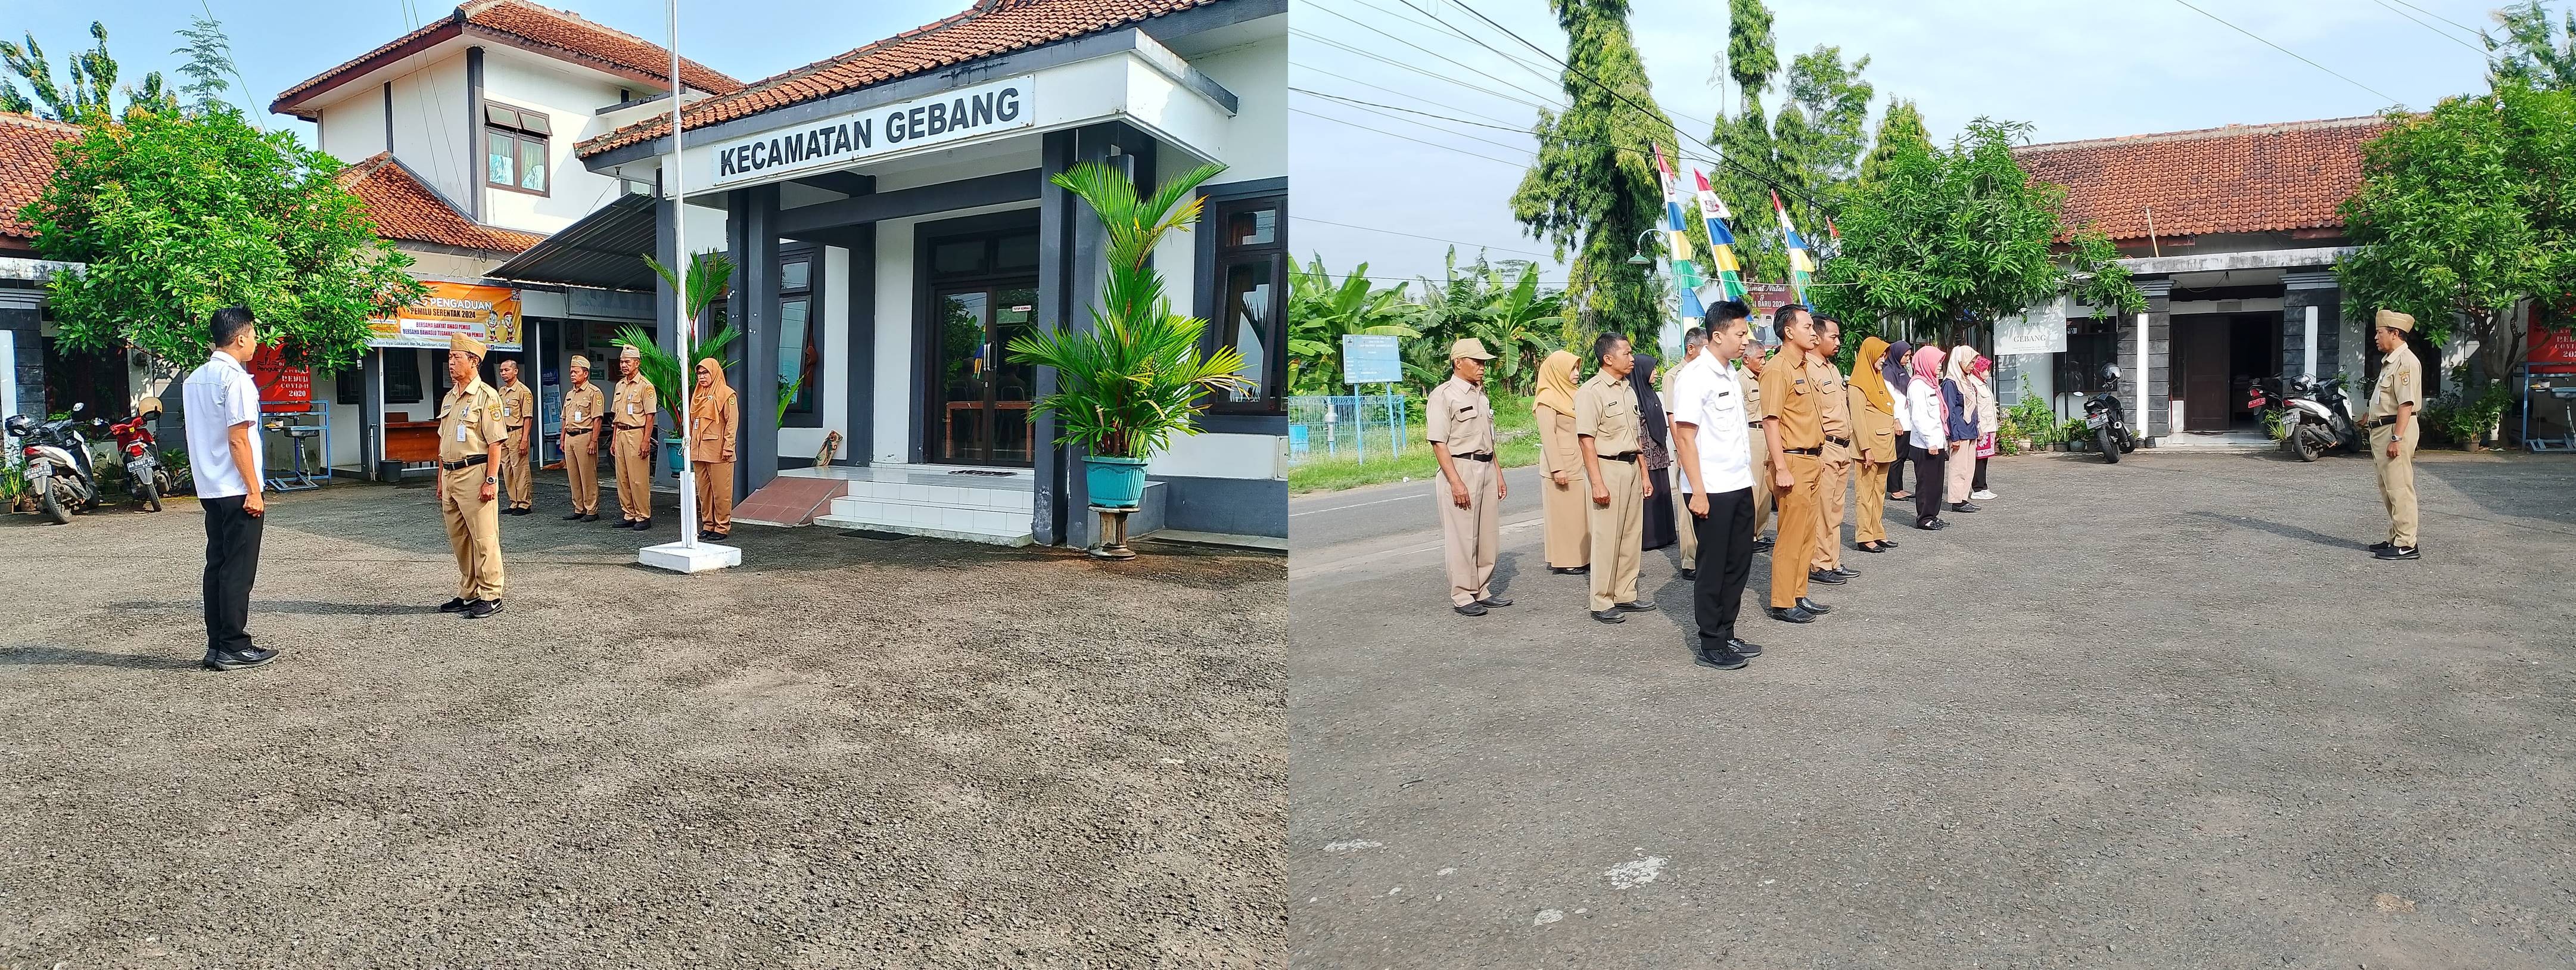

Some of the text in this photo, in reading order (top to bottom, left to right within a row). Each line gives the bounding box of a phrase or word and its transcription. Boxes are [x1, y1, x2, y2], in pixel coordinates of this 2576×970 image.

[720, 87, 1019, 176] KECAMATAN GEBANG
[430, 297, 493, 311] PENGADUAN
[410, 306, 476, 319] PEMILU SERENTAK 2024
